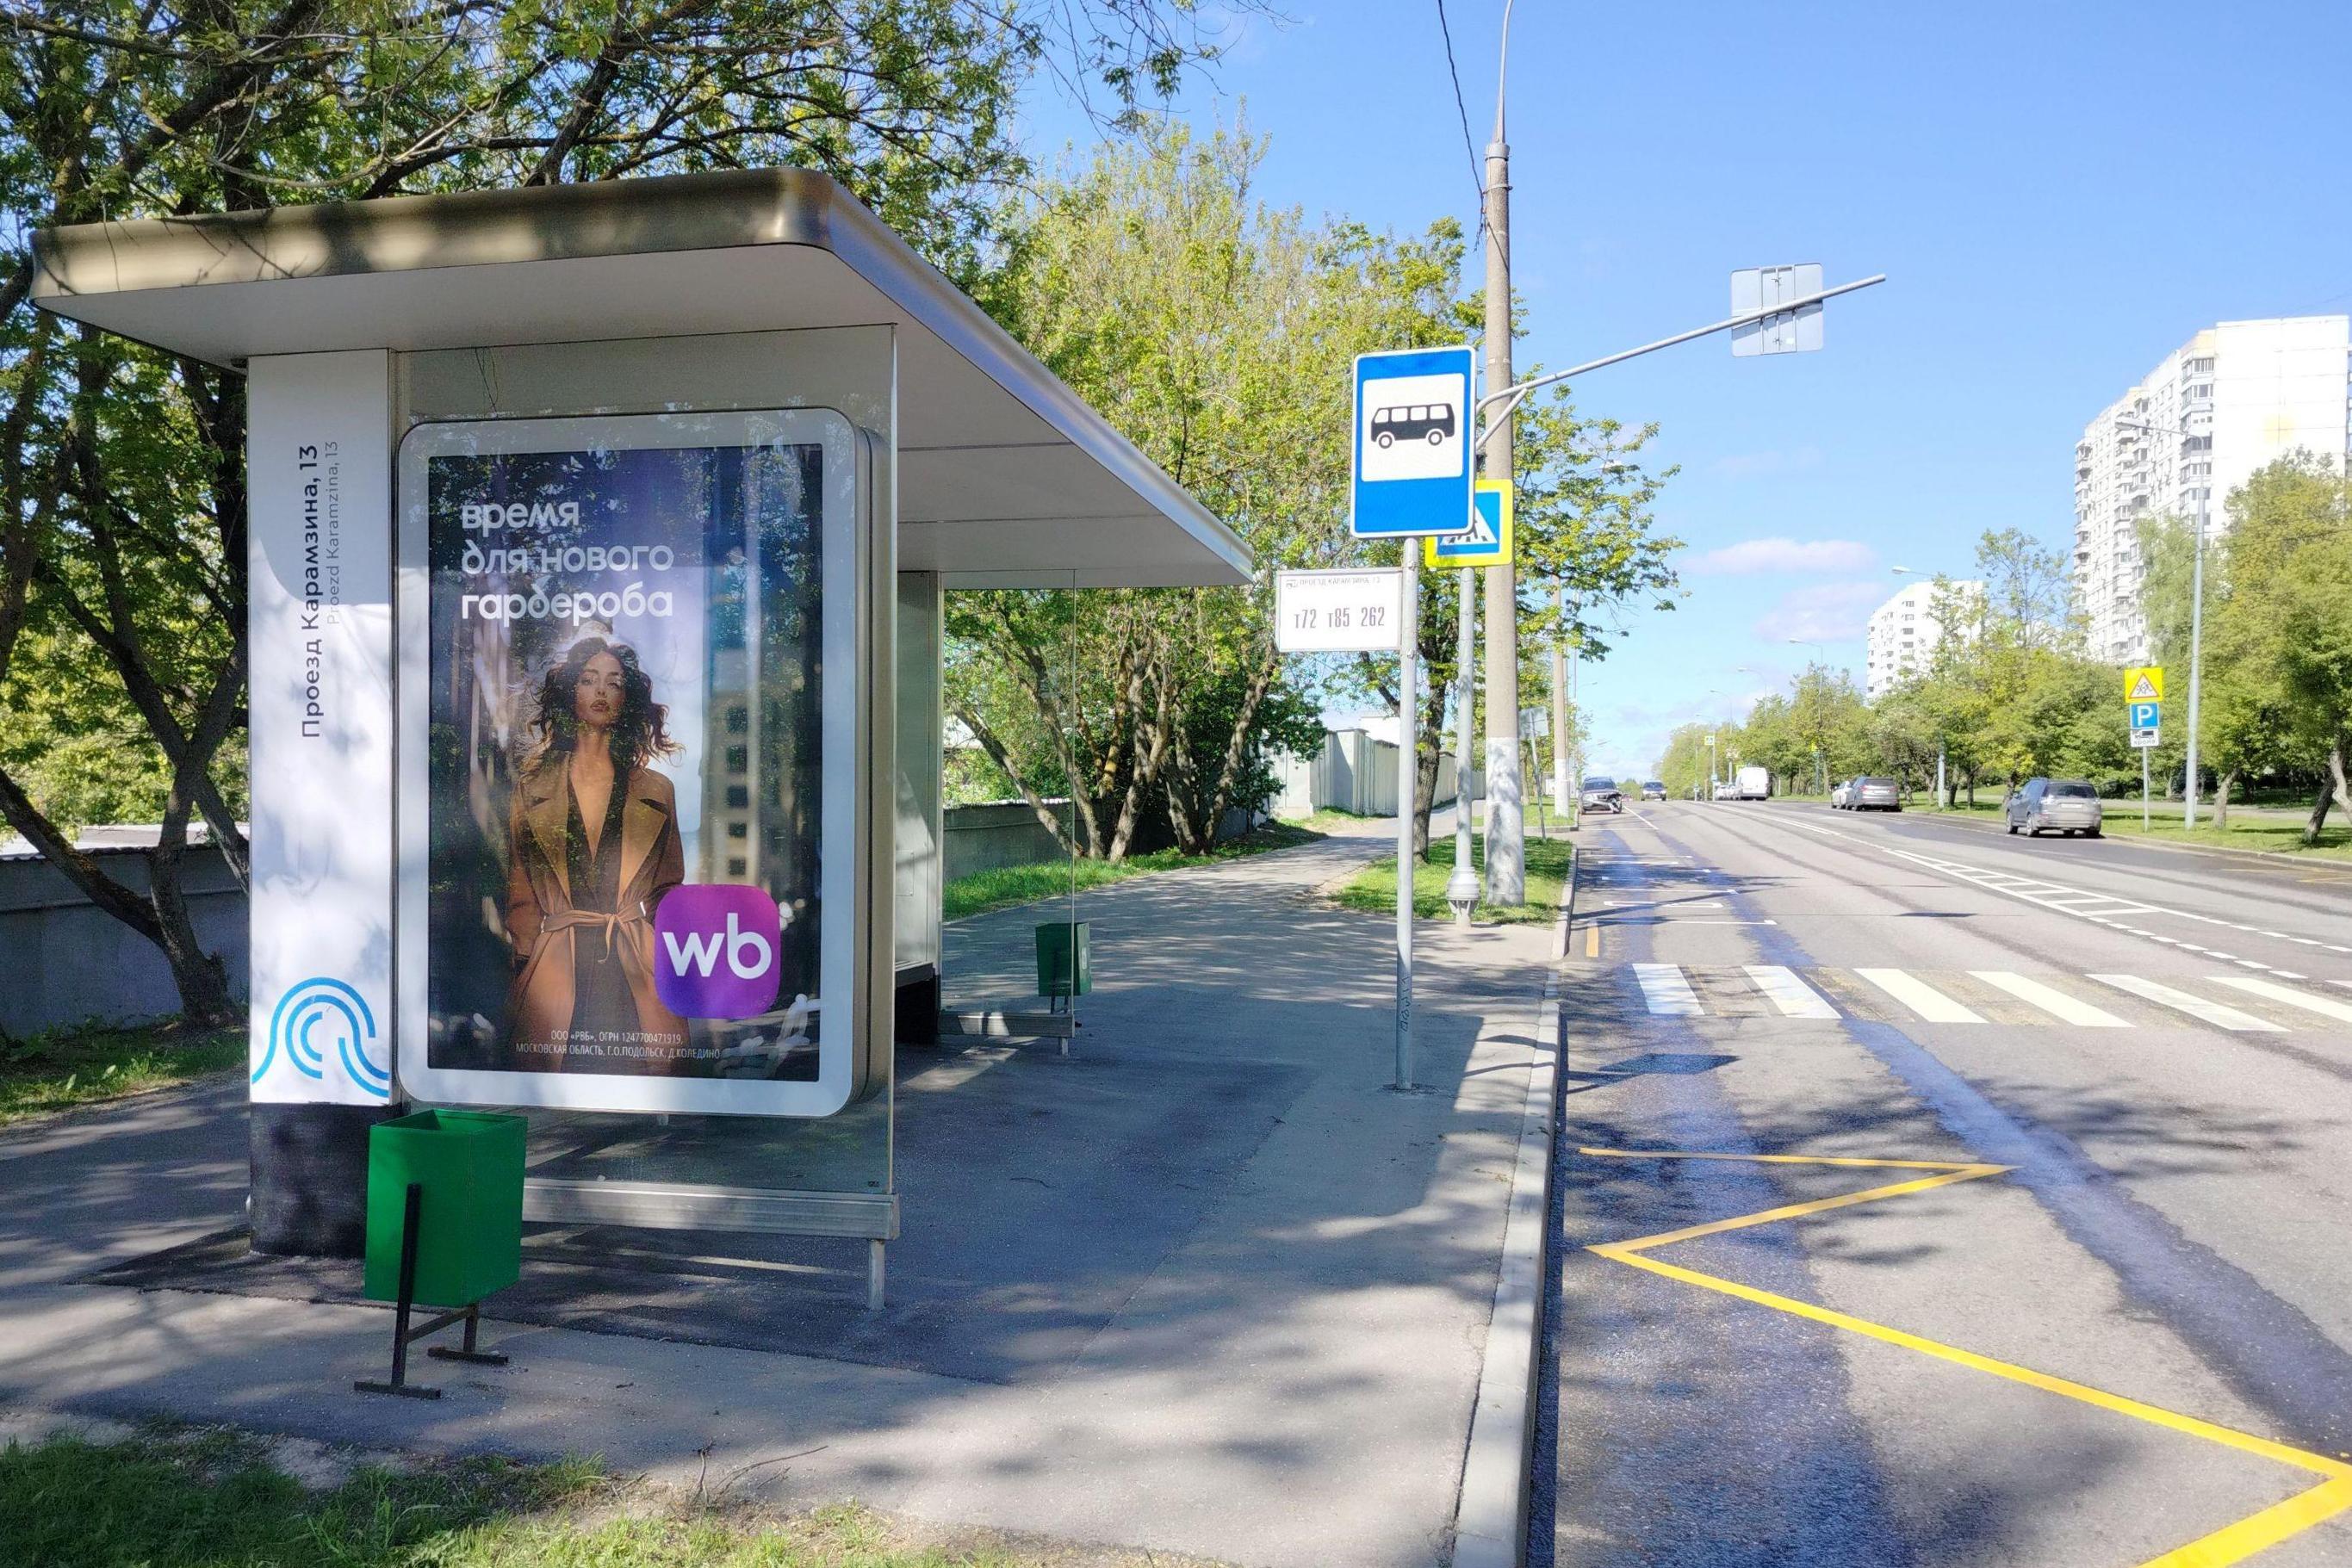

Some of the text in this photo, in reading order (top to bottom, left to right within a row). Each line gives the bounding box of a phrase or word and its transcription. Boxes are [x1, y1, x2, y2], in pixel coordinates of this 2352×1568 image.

[325, 441, 340, 625] Proezd Karamzina, 13
[462, 502, 579, 537] время
[462, 539, 674, 574] для нового
[299, 444, 324, 737] Проезд Карамзина, 13
[462, 581, 673, 627] гардероба
[1361, 606, 1385, 627] 262
[661, 913, 773, 979] wb
[516, 1043, 567, 1054] МОСКОВСКАЯ
[568, 1044, 605, 1056] ОБЛАСТЬ,
[551, 1030, 568, 1040] ООО
[599, 1032, 618, 1042] ОГРН
